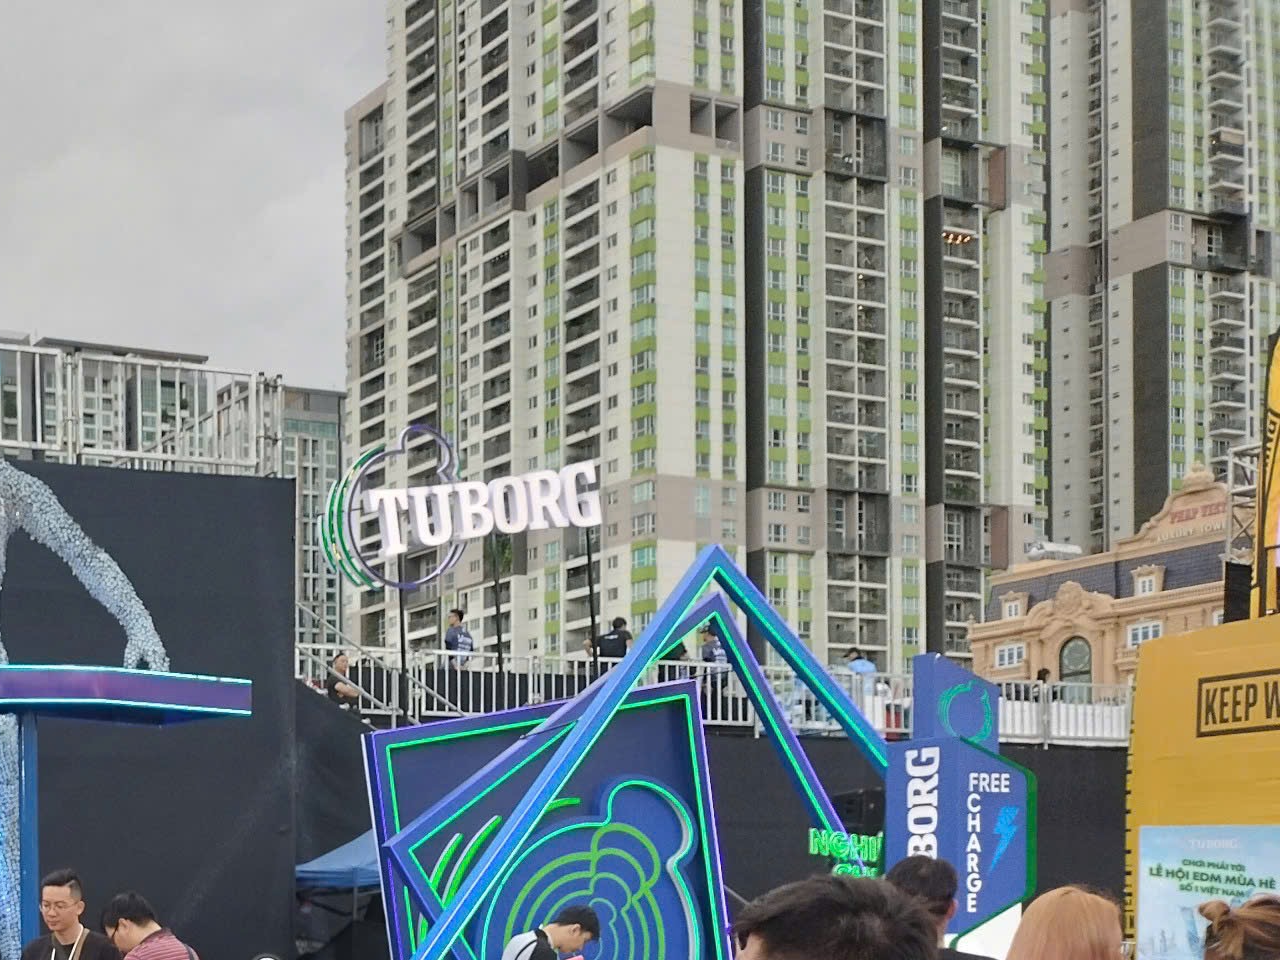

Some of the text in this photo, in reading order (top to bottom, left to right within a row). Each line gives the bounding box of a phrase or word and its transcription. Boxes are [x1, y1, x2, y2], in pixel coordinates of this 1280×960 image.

[369, 460, 602, 557] TUBORG
[1205, 683, 1258, 725] KEEP
[905, 747, 940, 860] BORG
[969, 773, 1010, 793] FREE
[966, 793, 982, 913] CHARGE
[1165, 867, 1190, 881] HỘI
[1193, 872, 1222, 883] EDM
[1225, 875, 1257, 887] MÙA
[1259, 877, 1277, 889] HÈ
[1222, 888, 1245, 897] NAM
